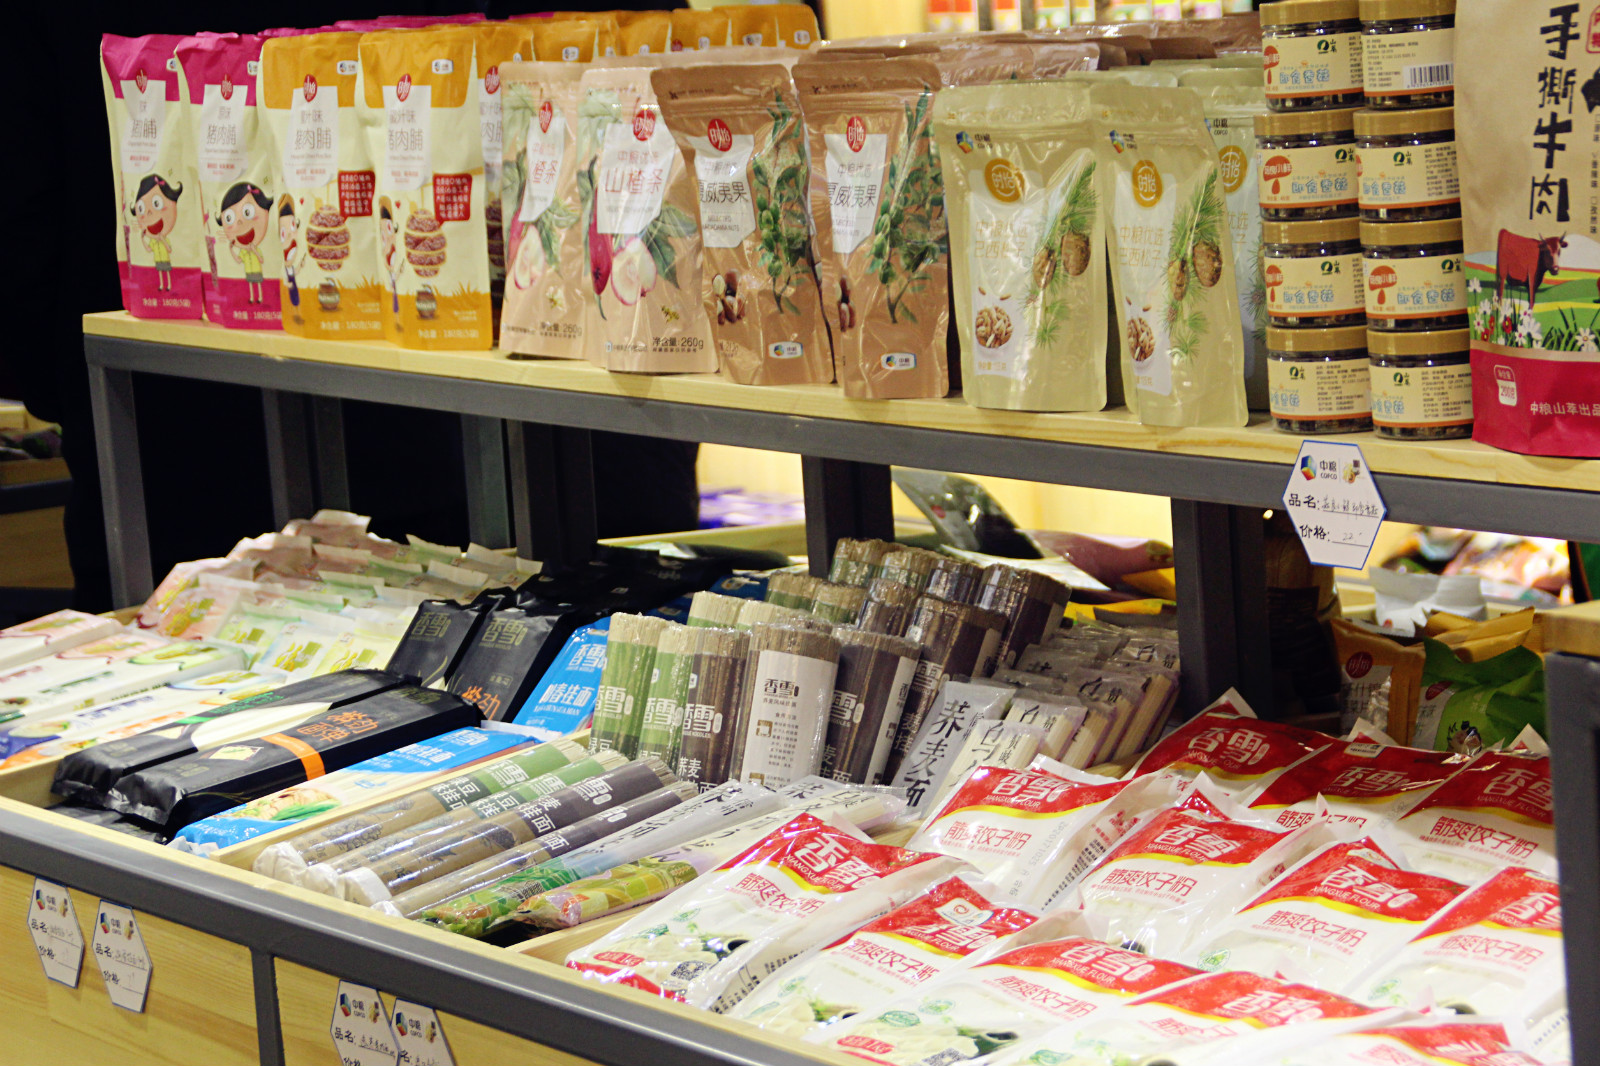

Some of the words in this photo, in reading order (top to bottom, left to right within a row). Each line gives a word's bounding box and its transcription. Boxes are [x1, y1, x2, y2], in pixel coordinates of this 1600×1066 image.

[533, 159, 558, 184] 楂条
[604, 168, 664, 194] 山楂条
[1530, 401, 1600, 416] 中粮山萃出品
[1319, 460, 1337, 471] 中粮
[1299, 524, 1330, 542] 价格:
[764, 678, 795, 696] 香雪
[1187, 727, 1267, 764] 香雪
[992, 770, 1064, 803] 香雪
[1332, 766, 1408, 792] 香雪
[1154, 824, 1240, 858] 香雪
[1430, 816, 1539, 860] 筋爽饺子粉
[794, 833, 880, 885] 香雪
[1101, 867, 1198, 897] 筋爽饺子粉
[1320, 863, 1409, 903] 香雪
[1350, 893, 1381, 911] FLOUR
[1263, 909, 1368, 947] 筋爽饺子粉
[1060, 942, 1149, 977] 香雪
[1088, 969, 1116, 985] FLOUR
